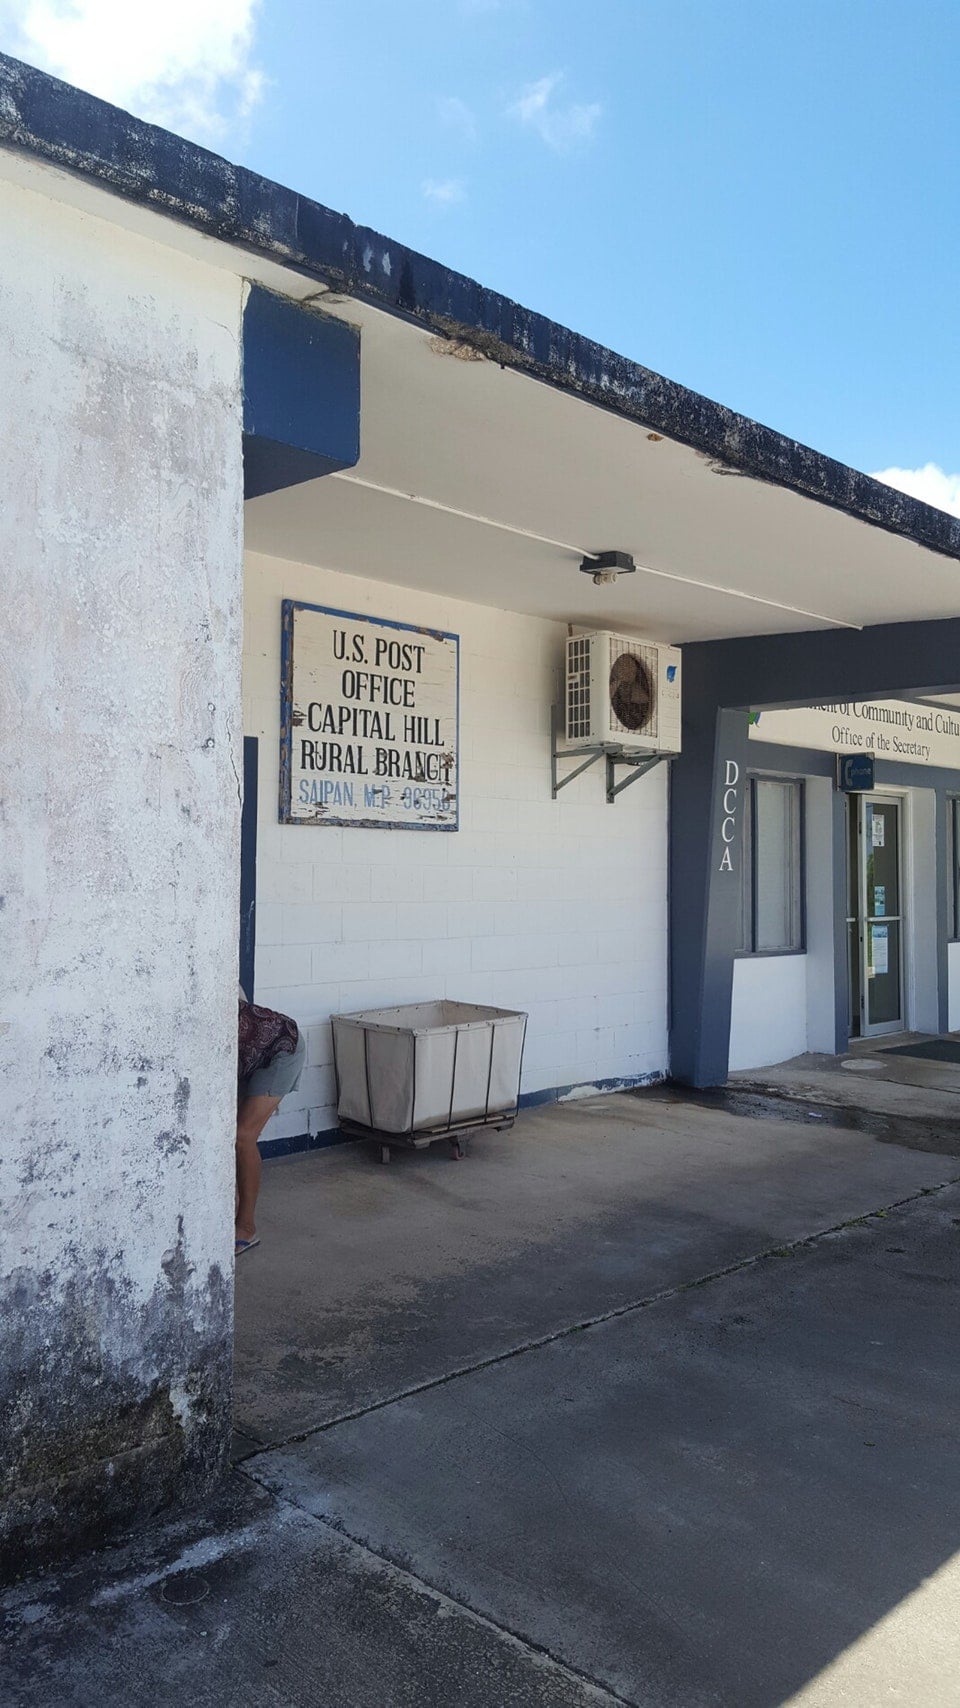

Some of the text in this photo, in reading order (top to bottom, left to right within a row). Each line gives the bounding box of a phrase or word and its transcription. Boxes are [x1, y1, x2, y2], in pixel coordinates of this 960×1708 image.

[332, 629, 426, 674] U.S. POST
[341, 669, 416, 709] OFFICE
[307, 702, 445, 747] CAPITAL HILL
[853, 701, 915, 732] Community
[916, 712, 934, 732] and
[300, 739, 369, 776] RURAL
[831, 725, 931, 761] Office of the Secretary
[299, 779, 358, 810] SAIPAN,
